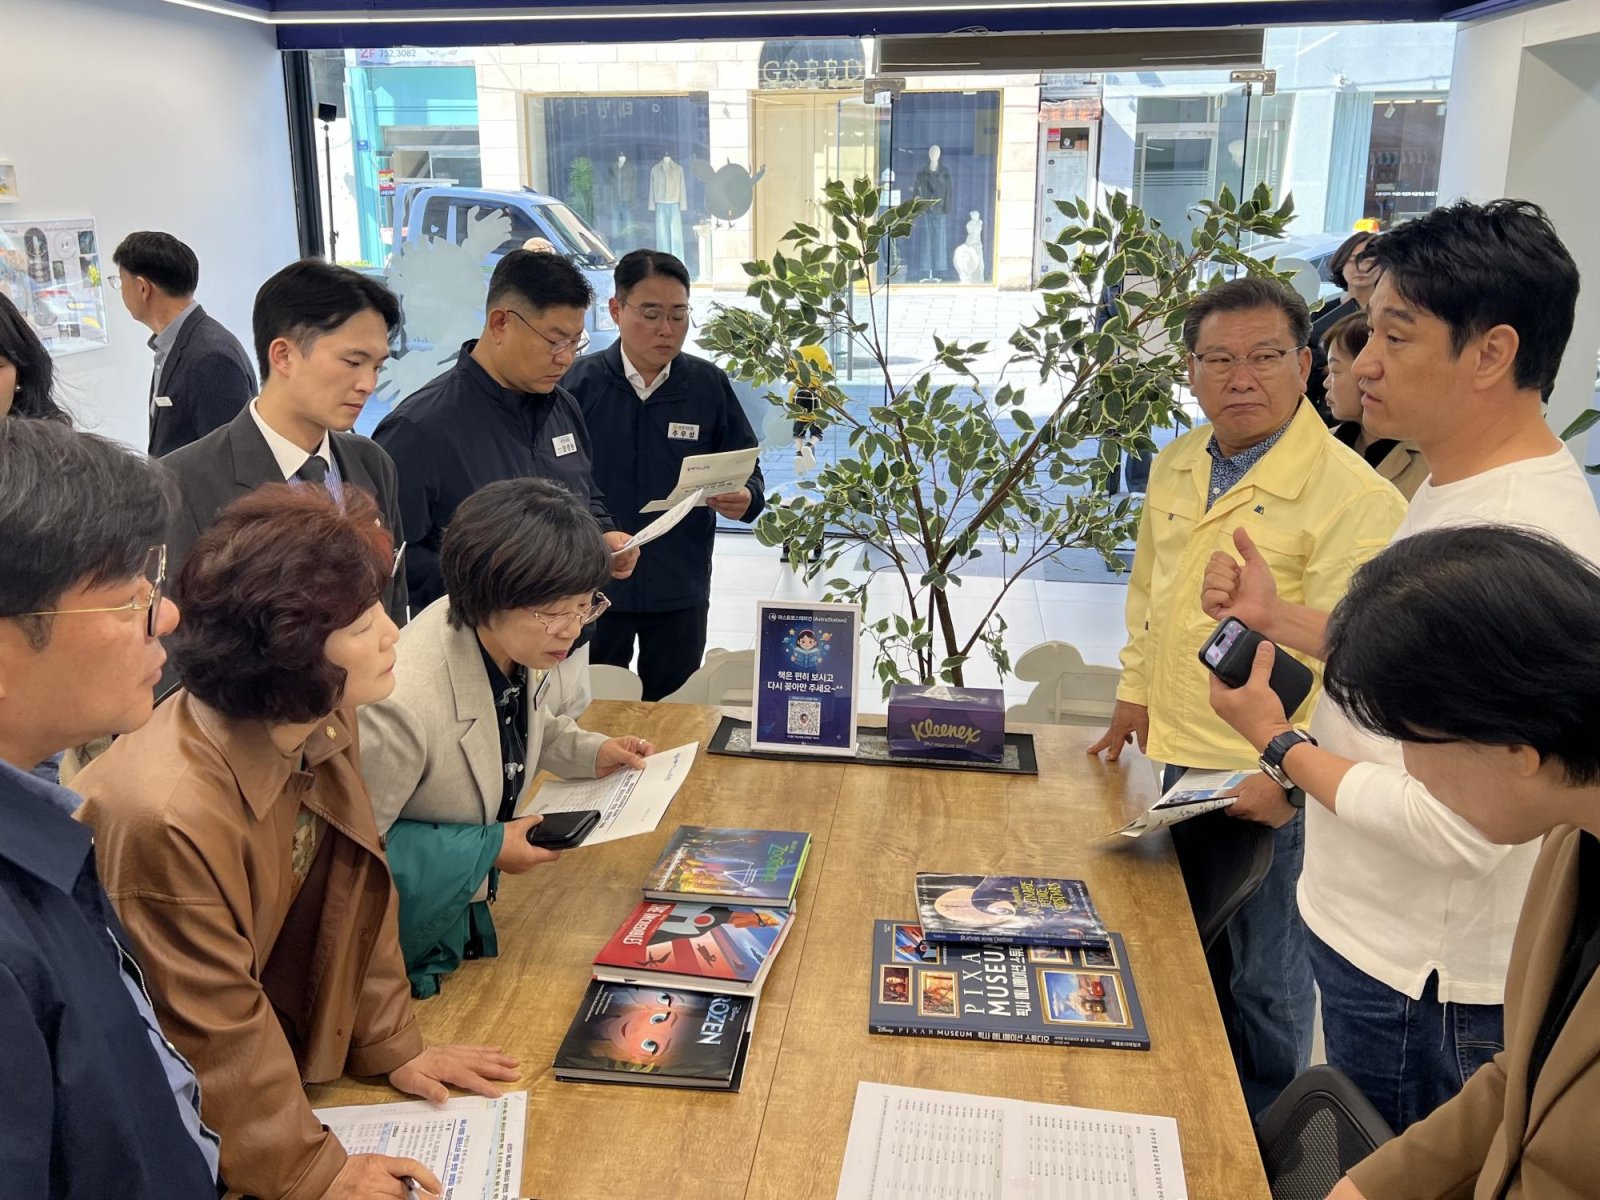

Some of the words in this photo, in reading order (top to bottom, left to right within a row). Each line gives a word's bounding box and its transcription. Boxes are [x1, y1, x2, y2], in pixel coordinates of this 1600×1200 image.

[767, 681, 783, 691] 다시
[784, 682, 807, 692] 꽂아만
[777, 670, 793, 681] 책은
[794, 672, 810, 682] 편히
[811, 673, 834, 682] 보시고
[910, 718, 981, 744] Kleenex
[961, 952, 985, 1015] PIXA
[1011, 964, 1030, 1000] 애니메이션
[696, 994, 732, 1046] ROZEN
[1014, 1001, 1032, 1017] 픽사
[876, 1025, 894, 1034] Disney
[898, 1027, 934, 1036] PIXAR
[937, 1030, 973, 1038] MUSEUM
[978, 1031, 991, 1040] 픽사
[992, 1033, 1023, 1042] 애니메이션
[1024, 1035, 1050, 1044] 스튜디오
